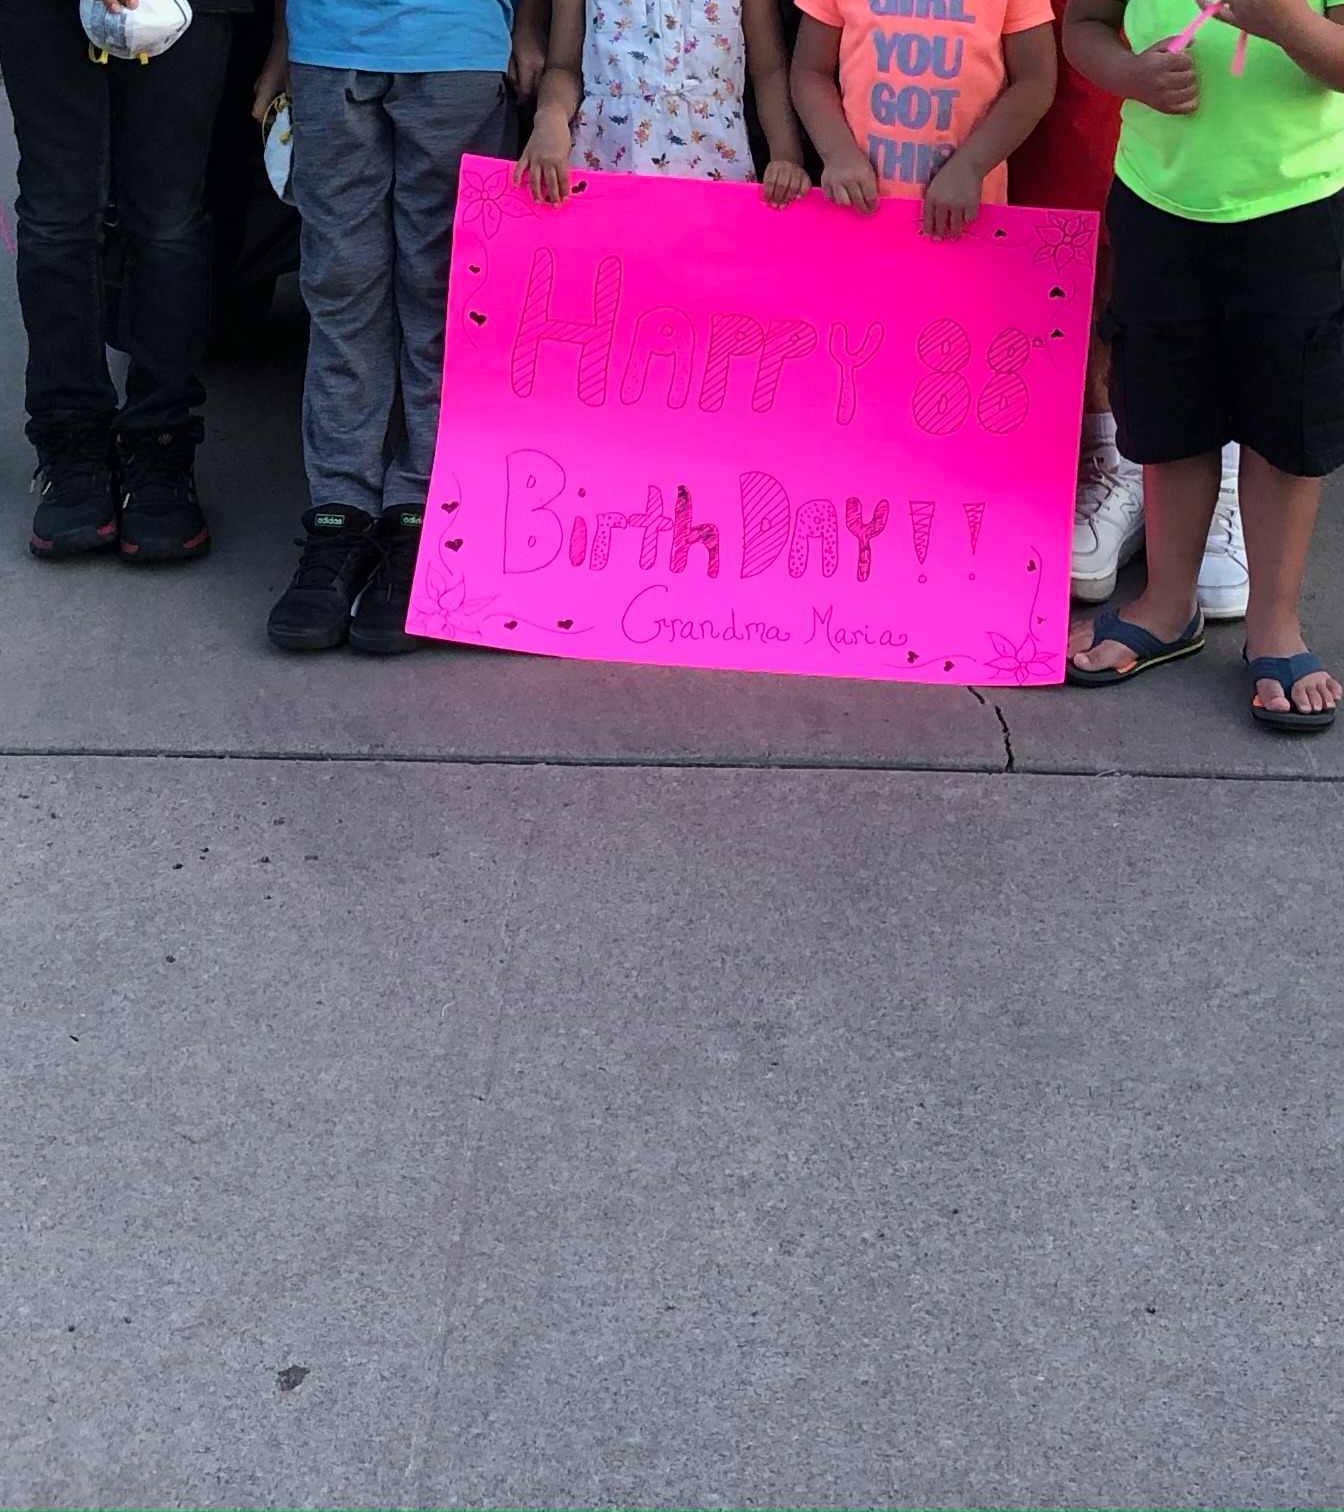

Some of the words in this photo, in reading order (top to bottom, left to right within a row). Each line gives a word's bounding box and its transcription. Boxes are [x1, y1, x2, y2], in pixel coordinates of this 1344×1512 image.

[871, 29, 964, 80] YOU
[870, 81, 960, 131] GOT
[912, 317, 1030, 435] 88
[317, 516, 343, 525] adidas
[621, 584, 792, 645] Grandma
[804, 604, 908, 654] Maria
